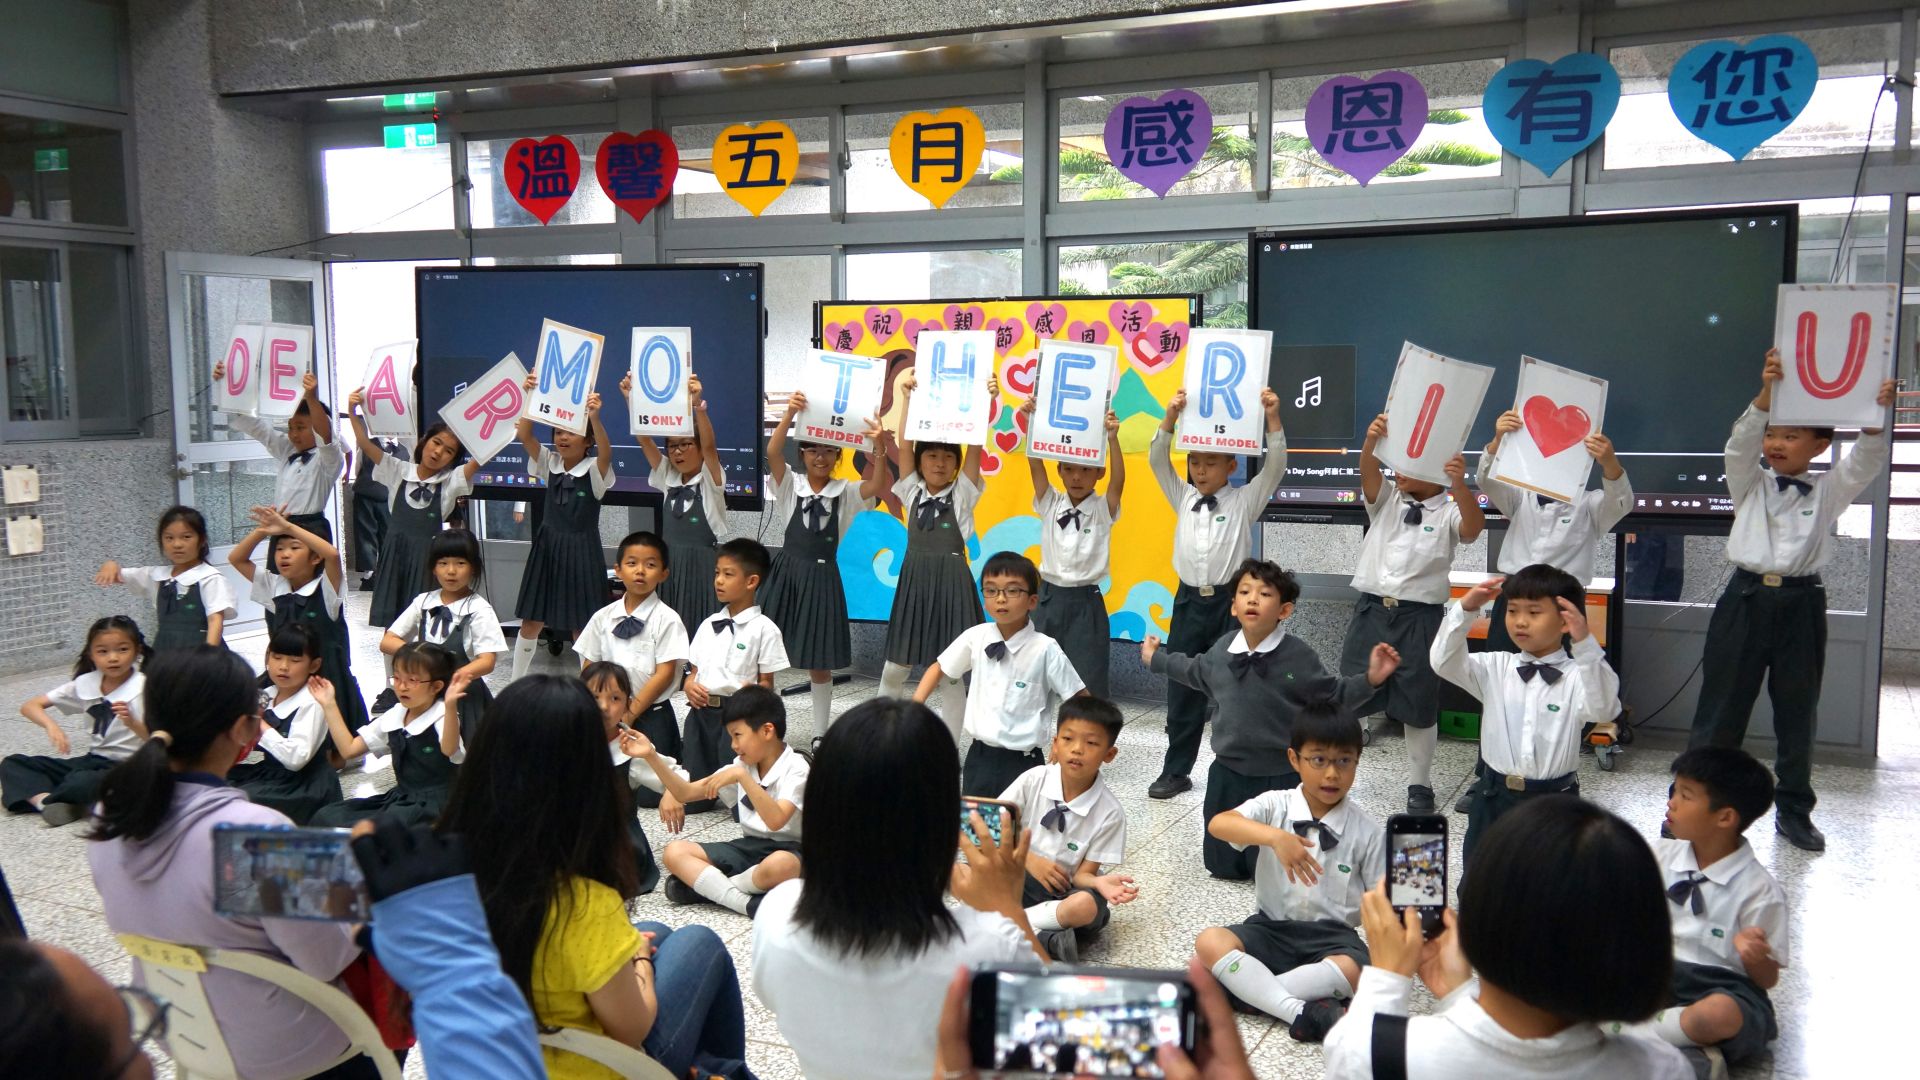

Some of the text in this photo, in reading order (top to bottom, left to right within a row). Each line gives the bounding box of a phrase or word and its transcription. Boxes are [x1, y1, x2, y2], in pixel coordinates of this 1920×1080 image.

[1796, 311, 1870, 399] U
[539, 330, 593, 405] M
[638, 335, 681, 404] O
[931, 341, 976, 412] H
[227, 338, 523, 440] D E A R
[820, 355, 872, 415] T
[1199, 342, 1247, 420] R
[1048, 352, 1097, 432] E
[540, 403, 574, 421] IS MY
[638, 415, 683, 426] IS ONLY
[831, 415, 845, 426] IS
[918, 420, 931, 430] IS
[1214, 425, 1226, 434] IS
[806, 426, 863, 445] TENDER
[1061, 434, 1072, 443] IS
[1182, 435, 1212, 446] ROLE
[1215, 438, 1259, 450] MODEL
[1032, 441, 1099, 459] EXCELLENT
[1292, 468, 1306, 476] Day
